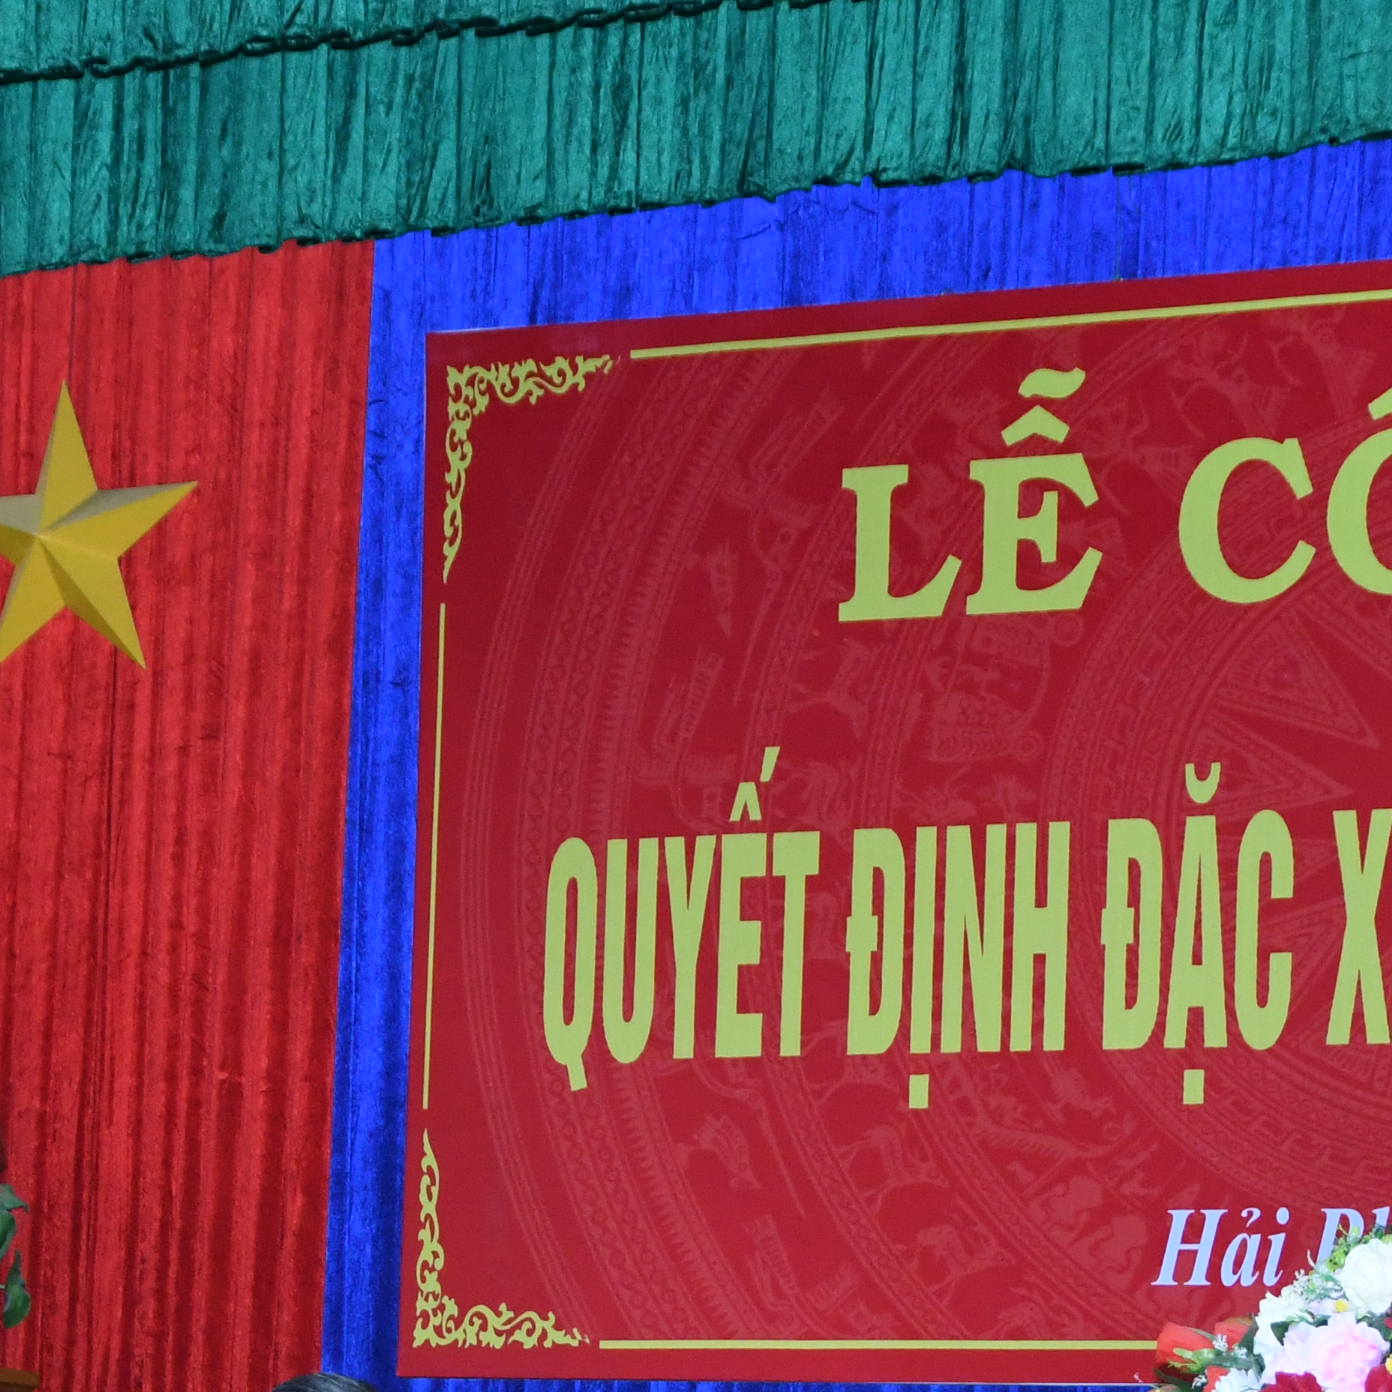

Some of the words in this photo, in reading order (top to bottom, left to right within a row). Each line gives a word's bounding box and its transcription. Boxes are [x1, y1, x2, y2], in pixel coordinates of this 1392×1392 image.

[839, 367, 1103, 622] LỄ
[543, 746, 821, 1091] QUYẾT
[846, 821, 1071, 1108] ĐỊNH
[1101, 762, 1295, 1105] ĐẶC
[1151, 1206, 1290, 1287] Hải
